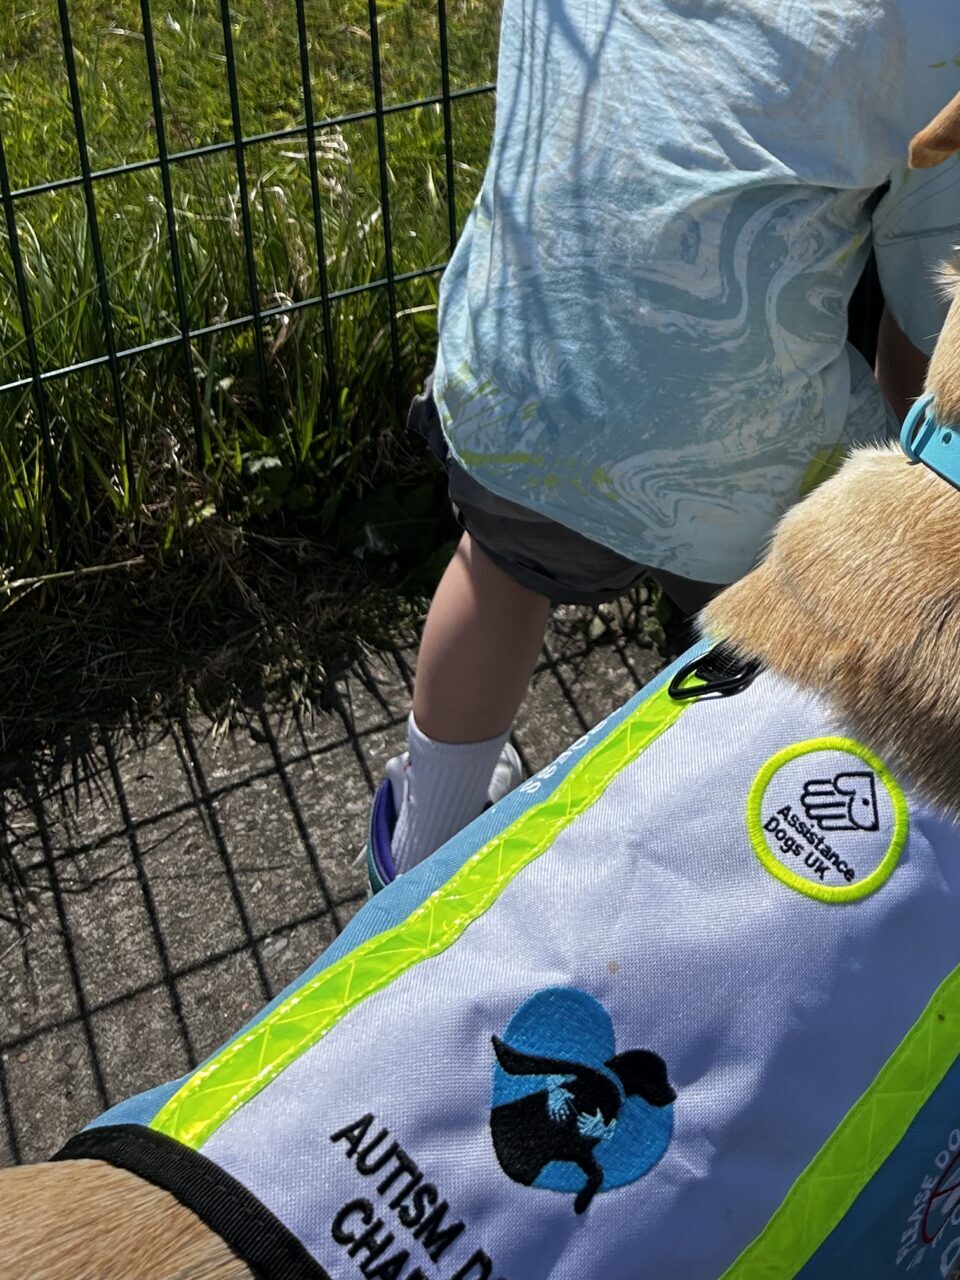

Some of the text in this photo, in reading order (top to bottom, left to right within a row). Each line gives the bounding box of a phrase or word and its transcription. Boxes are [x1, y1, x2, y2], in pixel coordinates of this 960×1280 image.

[763, 816, 832, 881] Dogs UK
[776, 804, 856, 882] Assistance
[329, 1112, 467, 1263] AUTISM
[331, 1198, 428, 1280] CHA
